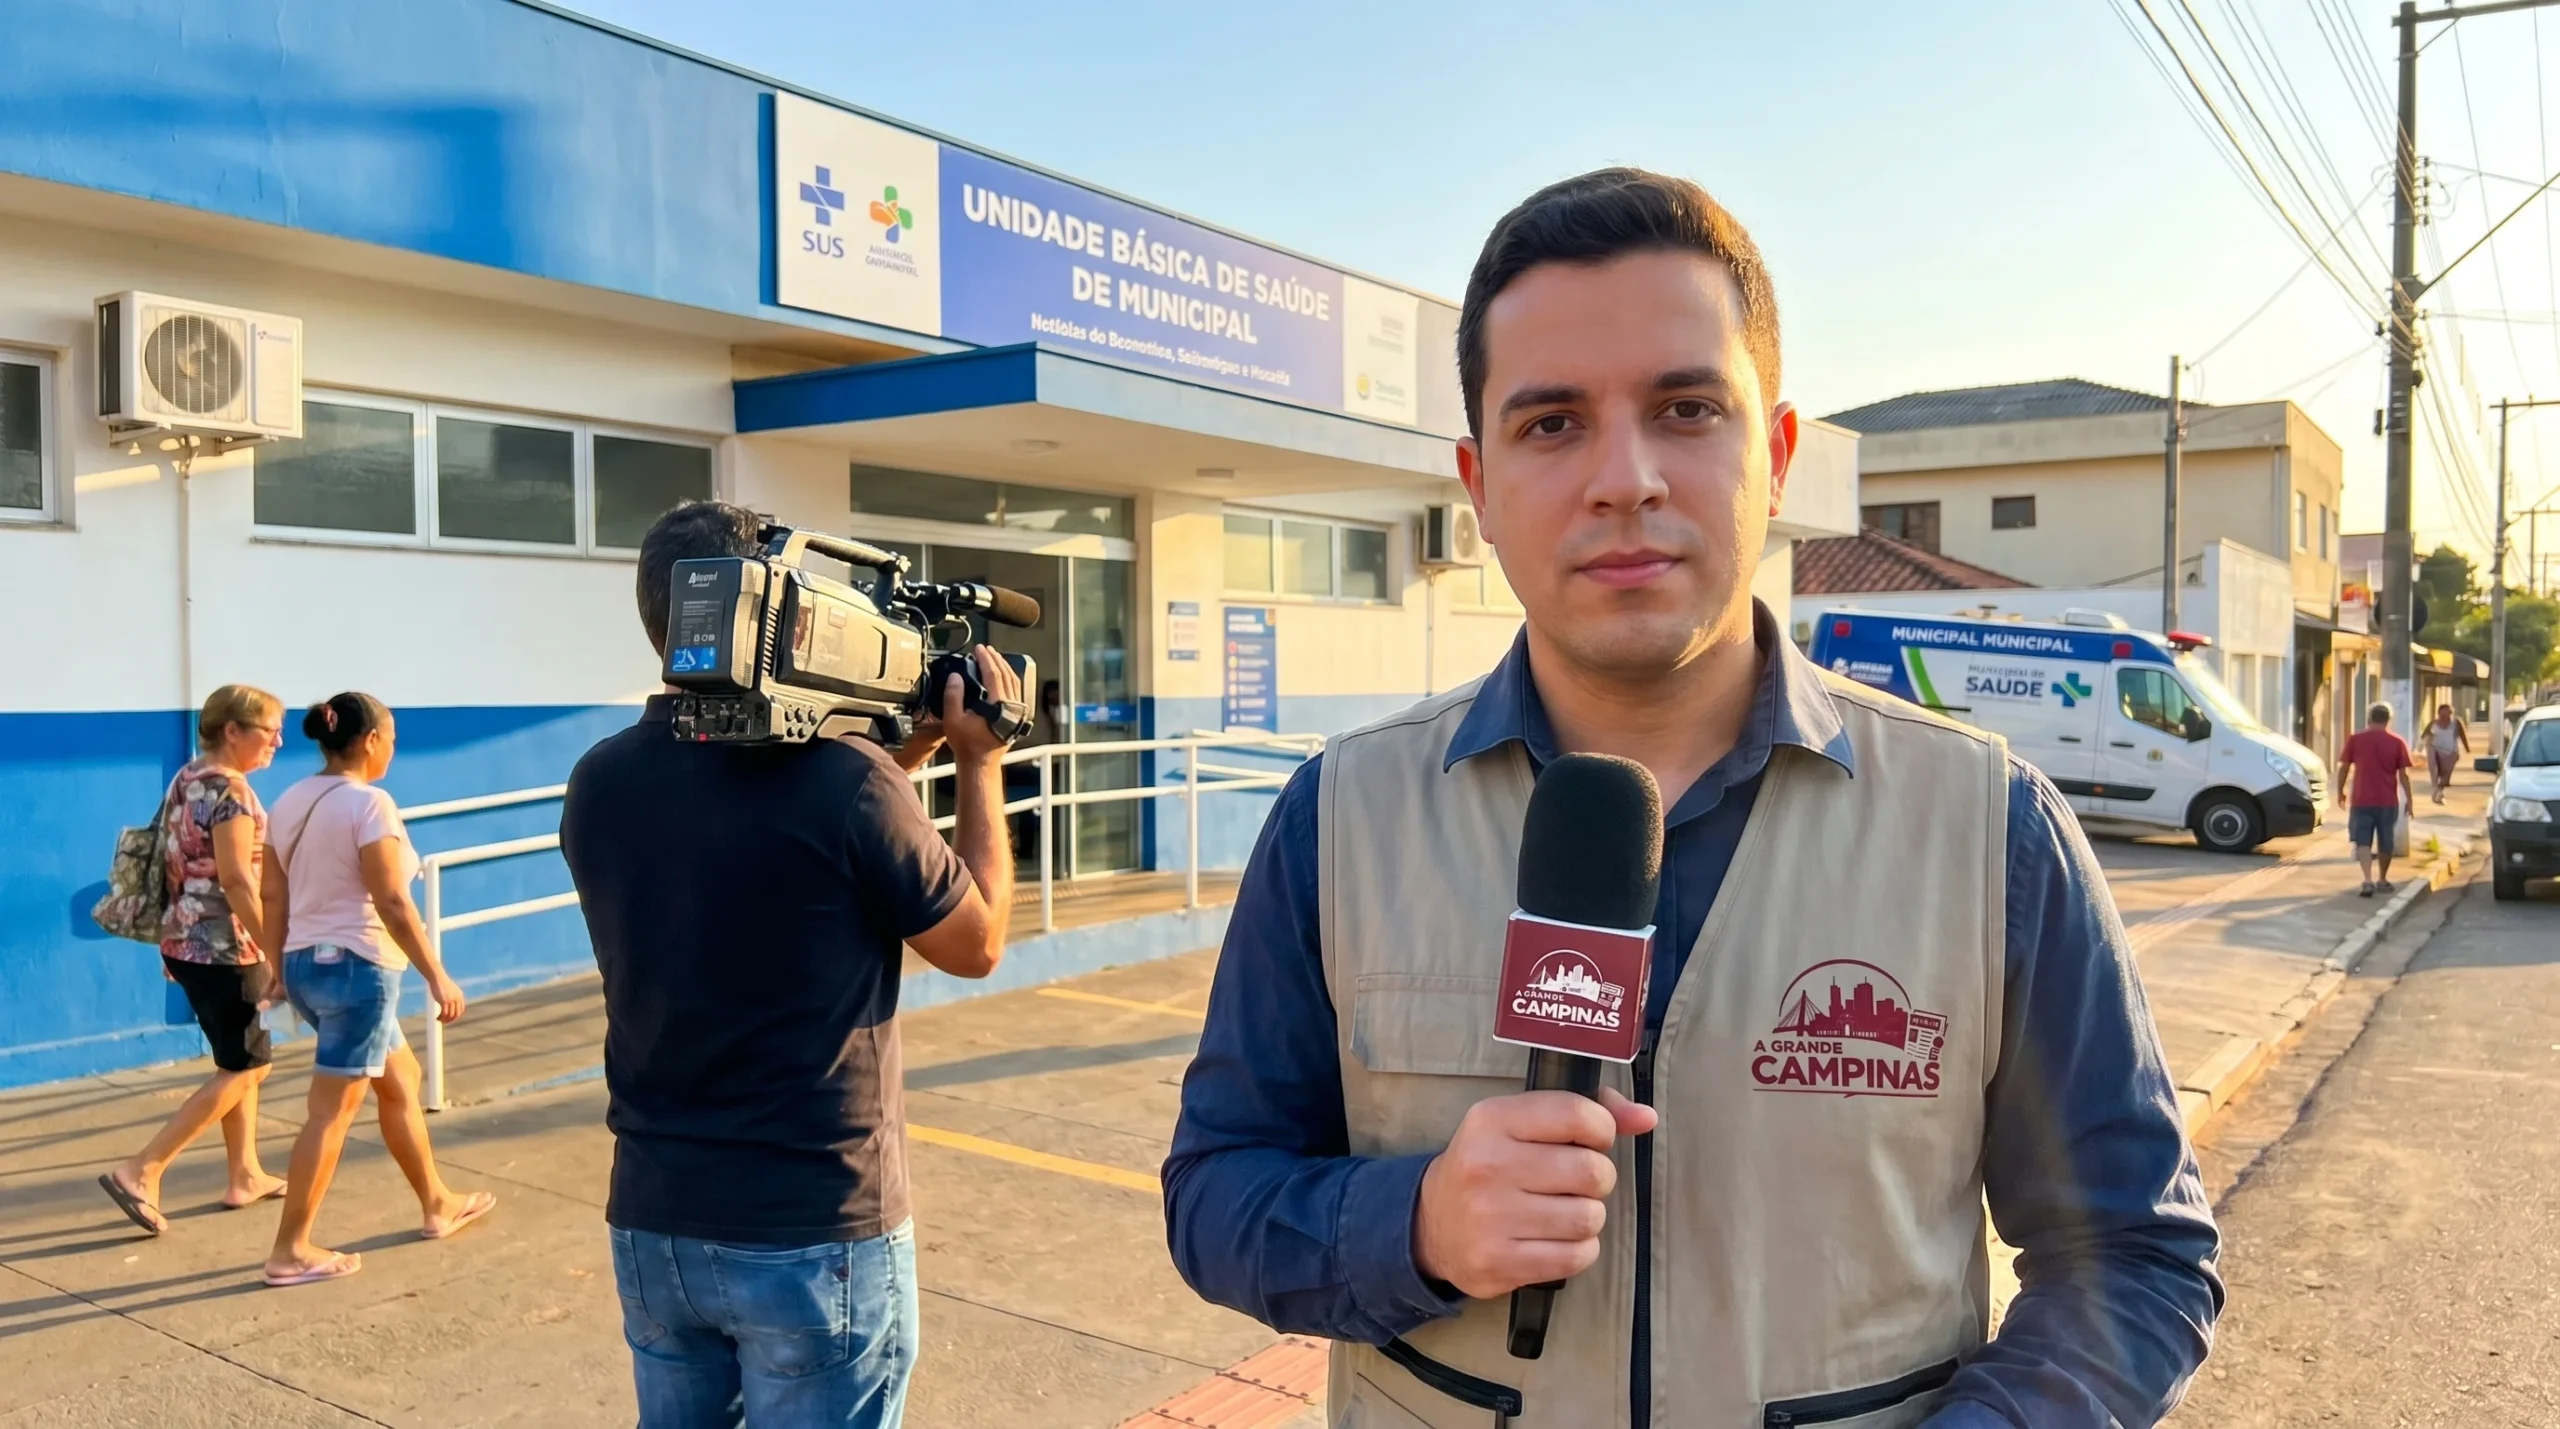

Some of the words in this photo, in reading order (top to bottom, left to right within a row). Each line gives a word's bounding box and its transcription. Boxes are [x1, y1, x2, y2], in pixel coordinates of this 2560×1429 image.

[802, 230, 845, 259] SUS
[963, 183, 1105, 258] UNIDADE
[1111, 228, 1211, 289] BÁSICA
[1216, 260, 1250, 299] DE
[1254, 275, 1330, 321] SAÚDE
[1072, 265, 1112, 308] DE
[1119, 279, 1258, 345] MUNICIPAL
[1891, 626, 1979, 647] MUNICIPAL
[1965, 676, 2043, 698] SAUDE
[1523, 990, 1565, 1002] GRANDE
[1512, 998, 1620, 1028] CAMPINAS
[1753, 1040, 1767, 1052] A
[1770, 1039, 1843, 1054] GRANDE
[1751, 1055, 1940, 1091] CAMPINAS
